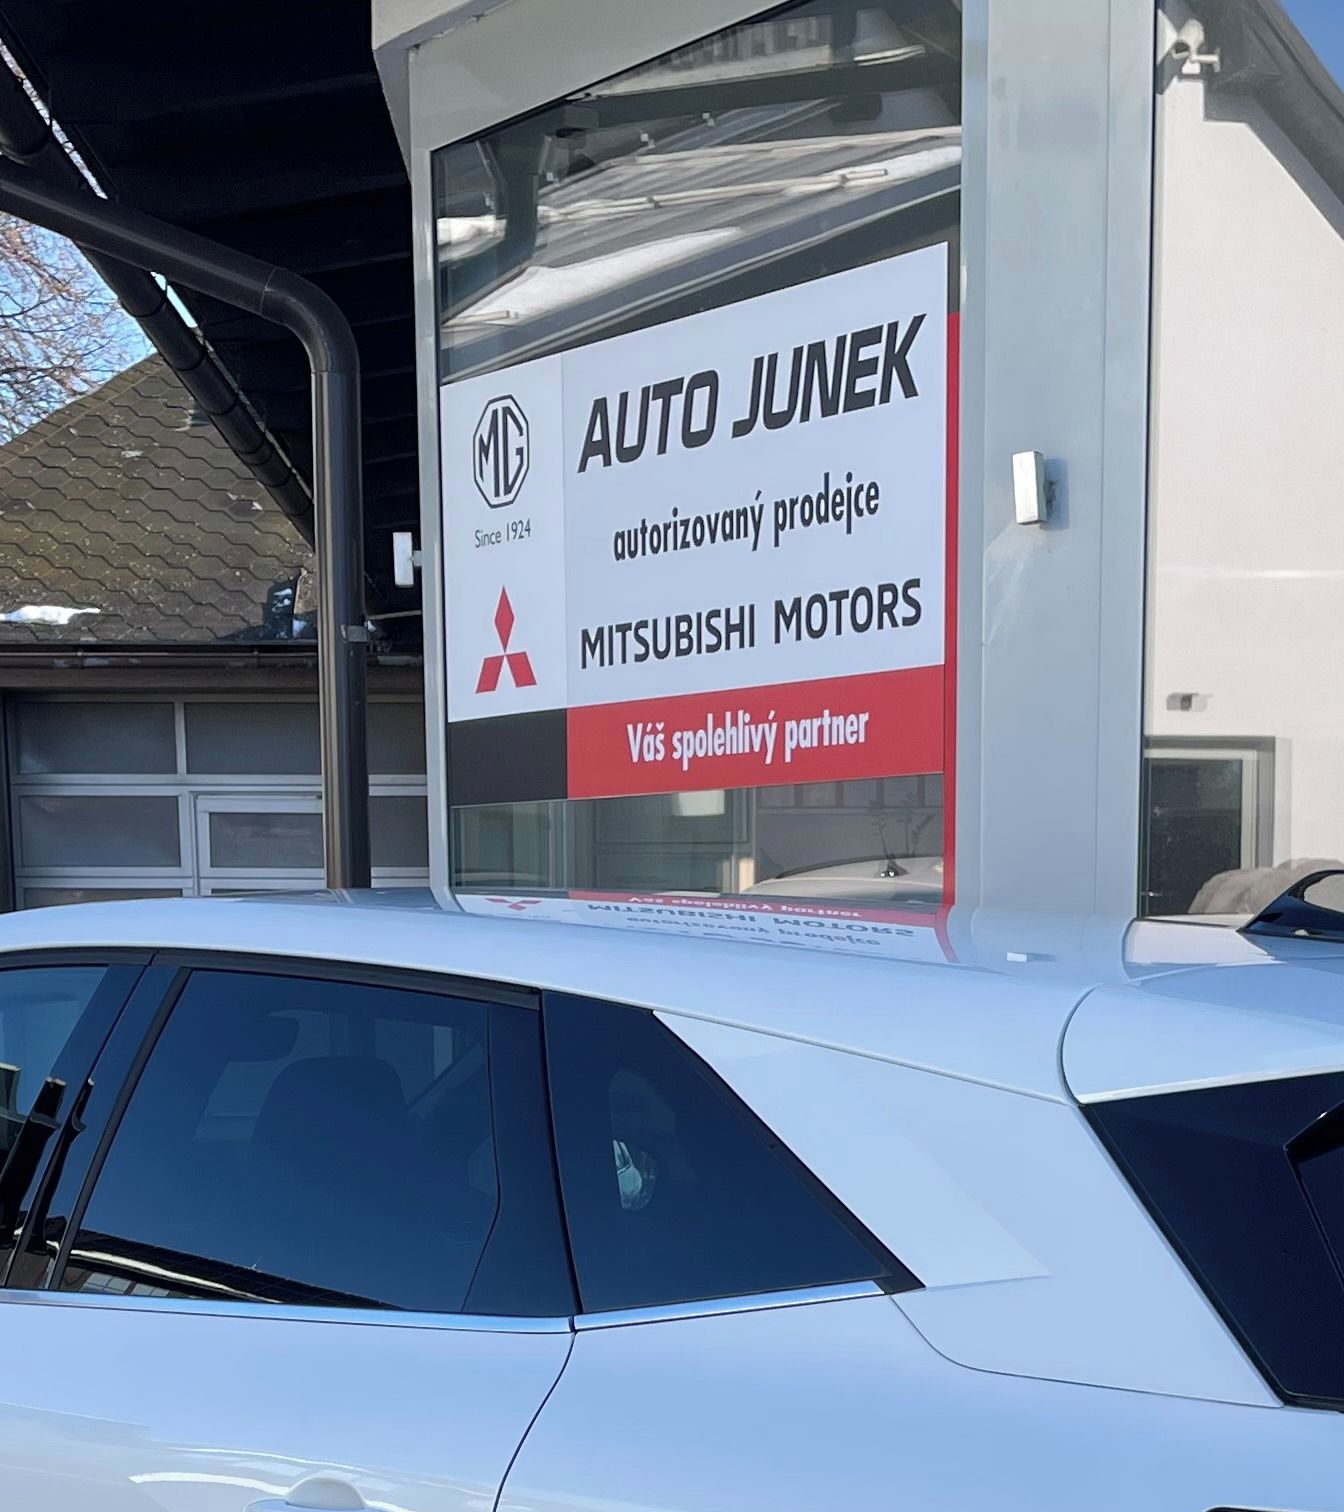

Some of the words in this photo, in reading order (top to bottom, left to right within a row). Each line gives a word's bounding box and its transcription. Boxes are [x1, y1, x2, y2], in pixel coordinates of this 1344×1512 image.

[577, 369, 719, 473] AUTO
[731, 313, 927, 439] JUNEK
[475, 400, 527, 503] MG
[474, 528, 502, 549] Since
[506, 517, 531, 543] 1924
[613, 490, 765, 562] autorizovaný
[773, 471, 879, 548] prodejce
[581, 603, 755, 669] MITSUBISHI
[773, 578, 922, 644] MOTORS
[626, 721, 665, 763] Váš
[671, 709, 778, 772] spolehlivý
[784, 708, 870, 763] partner
